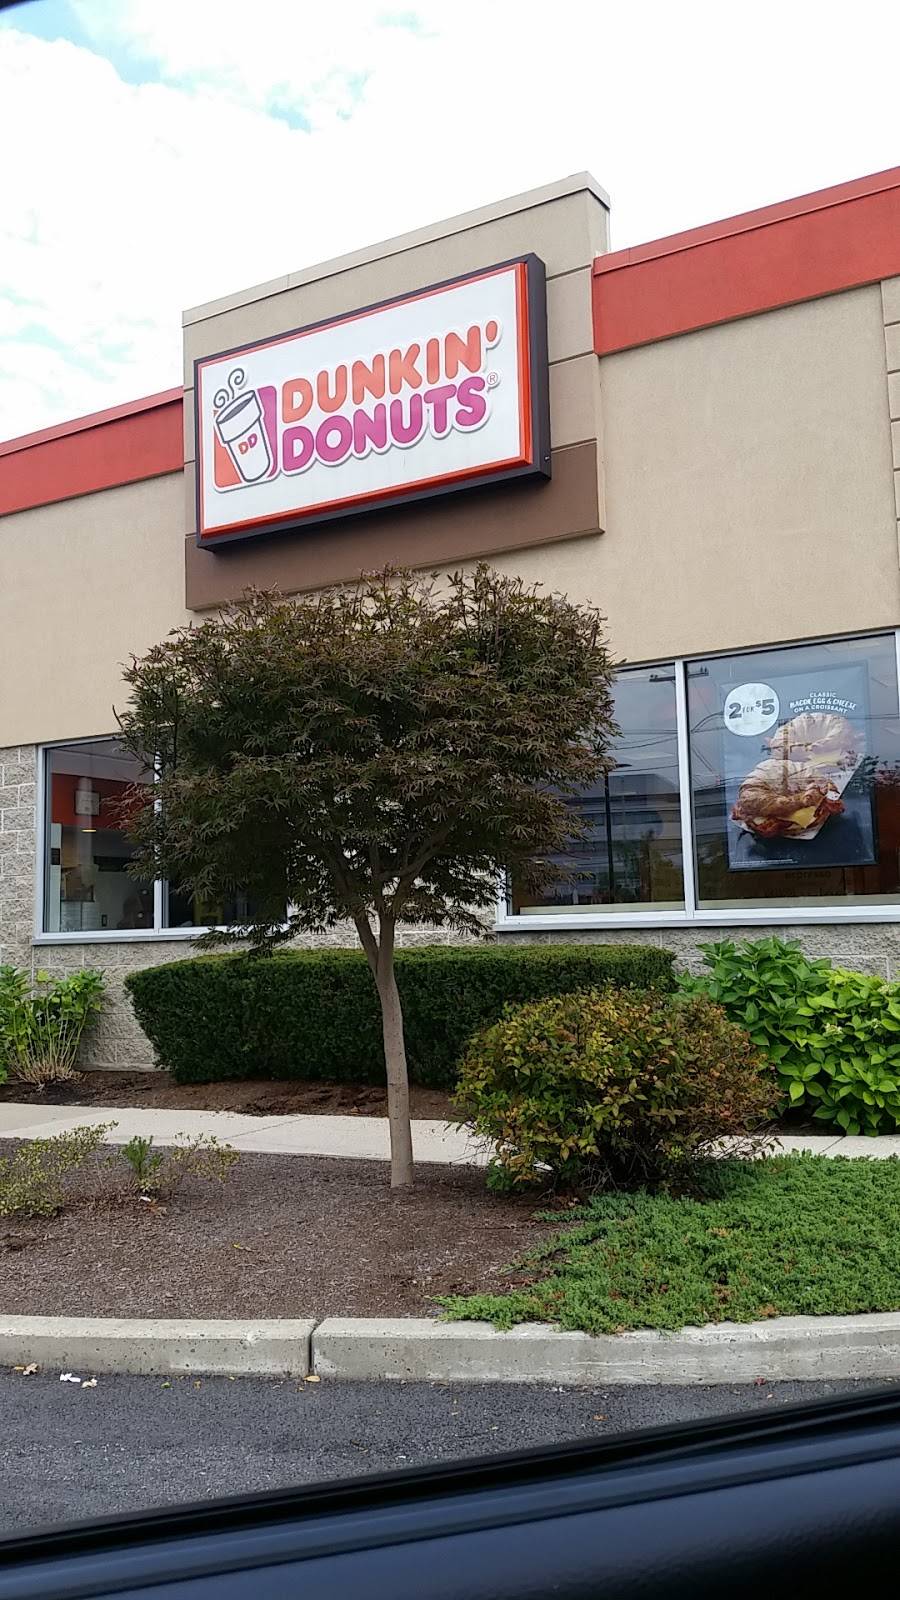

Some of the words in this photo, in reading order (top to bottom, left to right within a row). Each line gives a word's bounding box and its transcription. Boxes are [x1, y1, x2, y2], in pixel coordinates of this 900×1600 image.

[281, 320, 499, 424] DUNKIN'
[281, 376, 487, 472] DONUTS
[238, 433, 258, 455] DD
[728, 702, 743, 719] 2
[755, 698, 775, 716] $5
[793, 705, 804, 713] ON
[811, 704, 849, 714] CROISSANT
[826, 697, 833, 705] &
